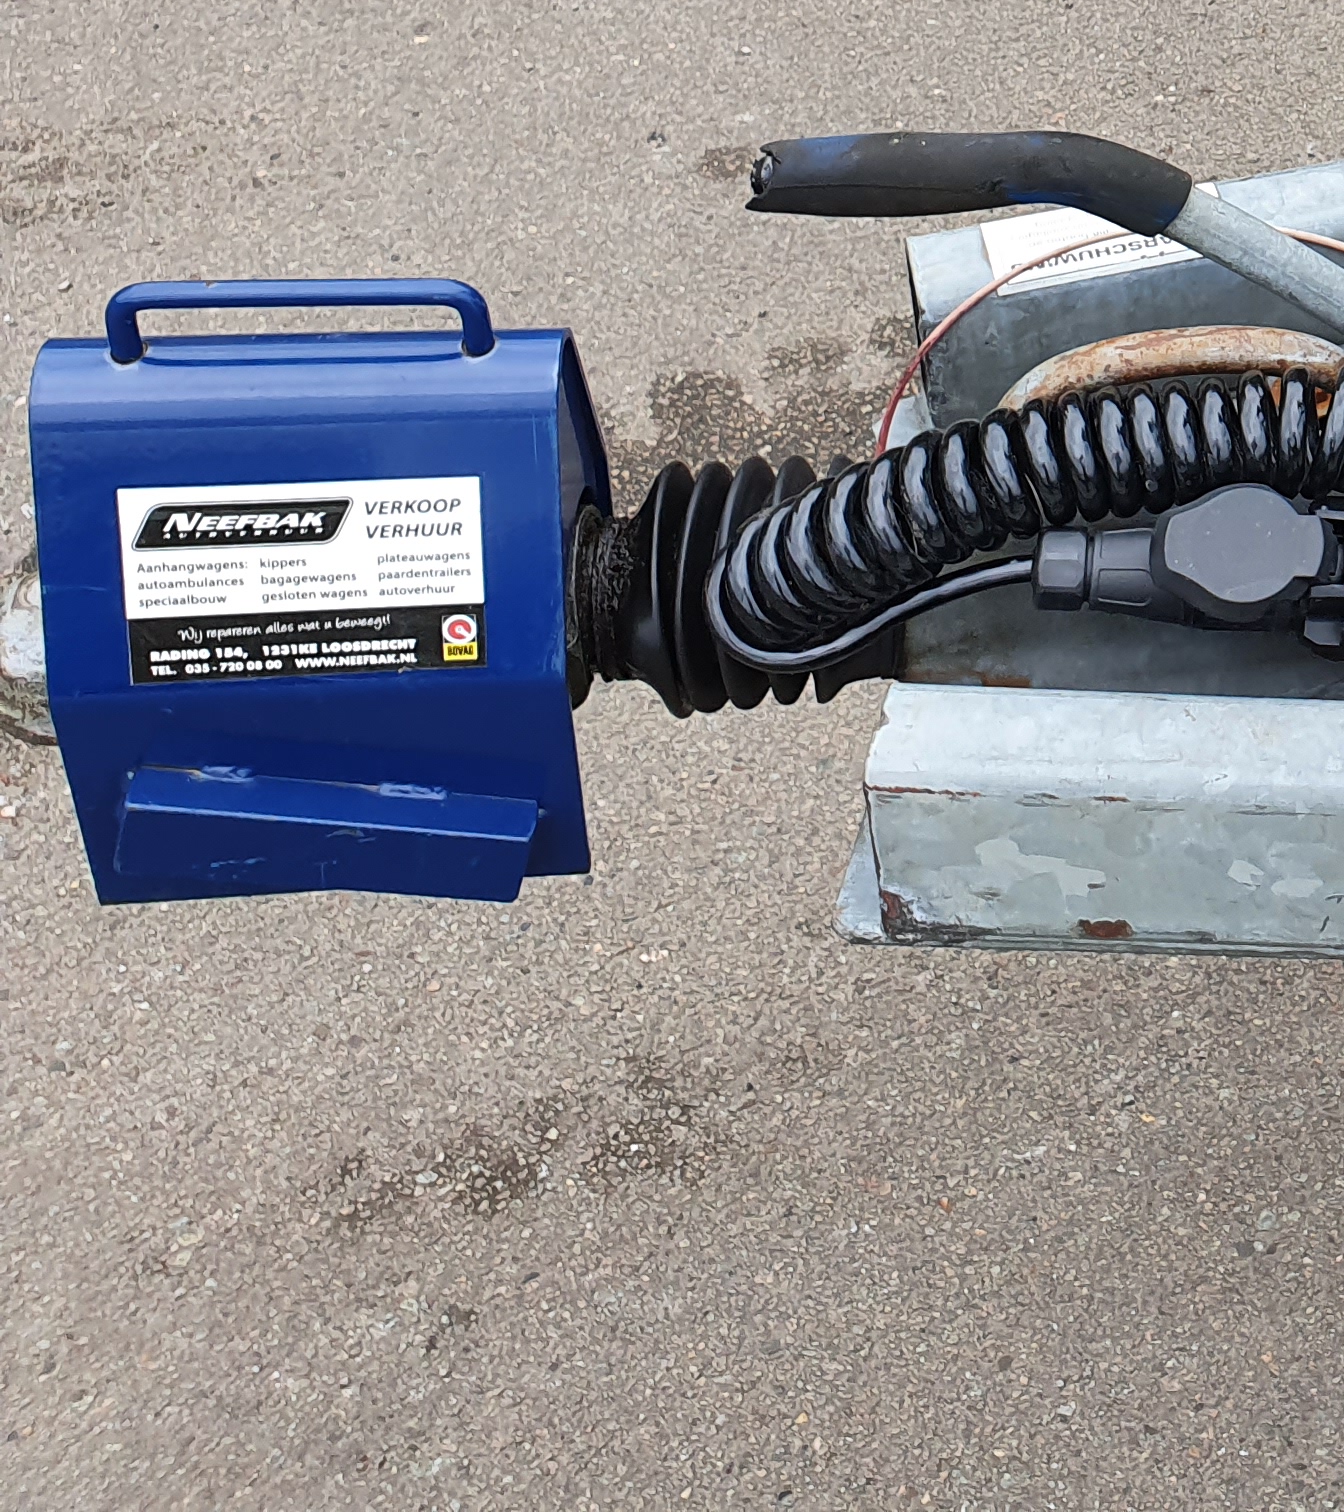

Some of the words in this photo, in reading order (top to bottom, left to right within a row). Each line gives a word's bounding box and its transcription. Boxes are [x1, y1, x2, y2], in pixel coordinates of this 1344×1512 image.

[365, 498, 462, 515] VERKOOP
[163, 512, 326, 532] NEEFBAK
[366, 522, 463, 539] VERHUUR
[259, 558, 306, 570] kippers
[377, 551, 470, 565] plateauwagens
[137, 561, 248, 574] Aanhangwagens:
[378, 567, 471, 582] paardentrailers
[138, 577, 244, 590] autoambulances
[261, 572, 357, 586] bagagewagens
[262, 590, 316, 604] gesloten
[320, 588, 368, 600] wagens
[379, 584, 455, 596] autoverhuur
[139, 594, 227, 609] speciaalbouw
[177, 626, 203, 644] Wij
[206, 625, 262, 642] repareren
[265, 621, 294, 634] alles
[297, 620, 321, 633] wat
[324, 621, 333, 630] u
[150, 648, 211, 662] RADING
[215, 646, 249, 660] 154,
[262, 643, 318, 657] 1231KE
[322, 639, 416, 654] LOOSDRECHT
[150, 665, 178, 676] TEL.
[184, 663, 210, 674] 035
[219, 661, 244, 673] 720
[246, 660, 263, 671] 08
[265, 659, 282, 670] 00
[295, 653, 418, 669] WWW.NEEFBAK.NL
